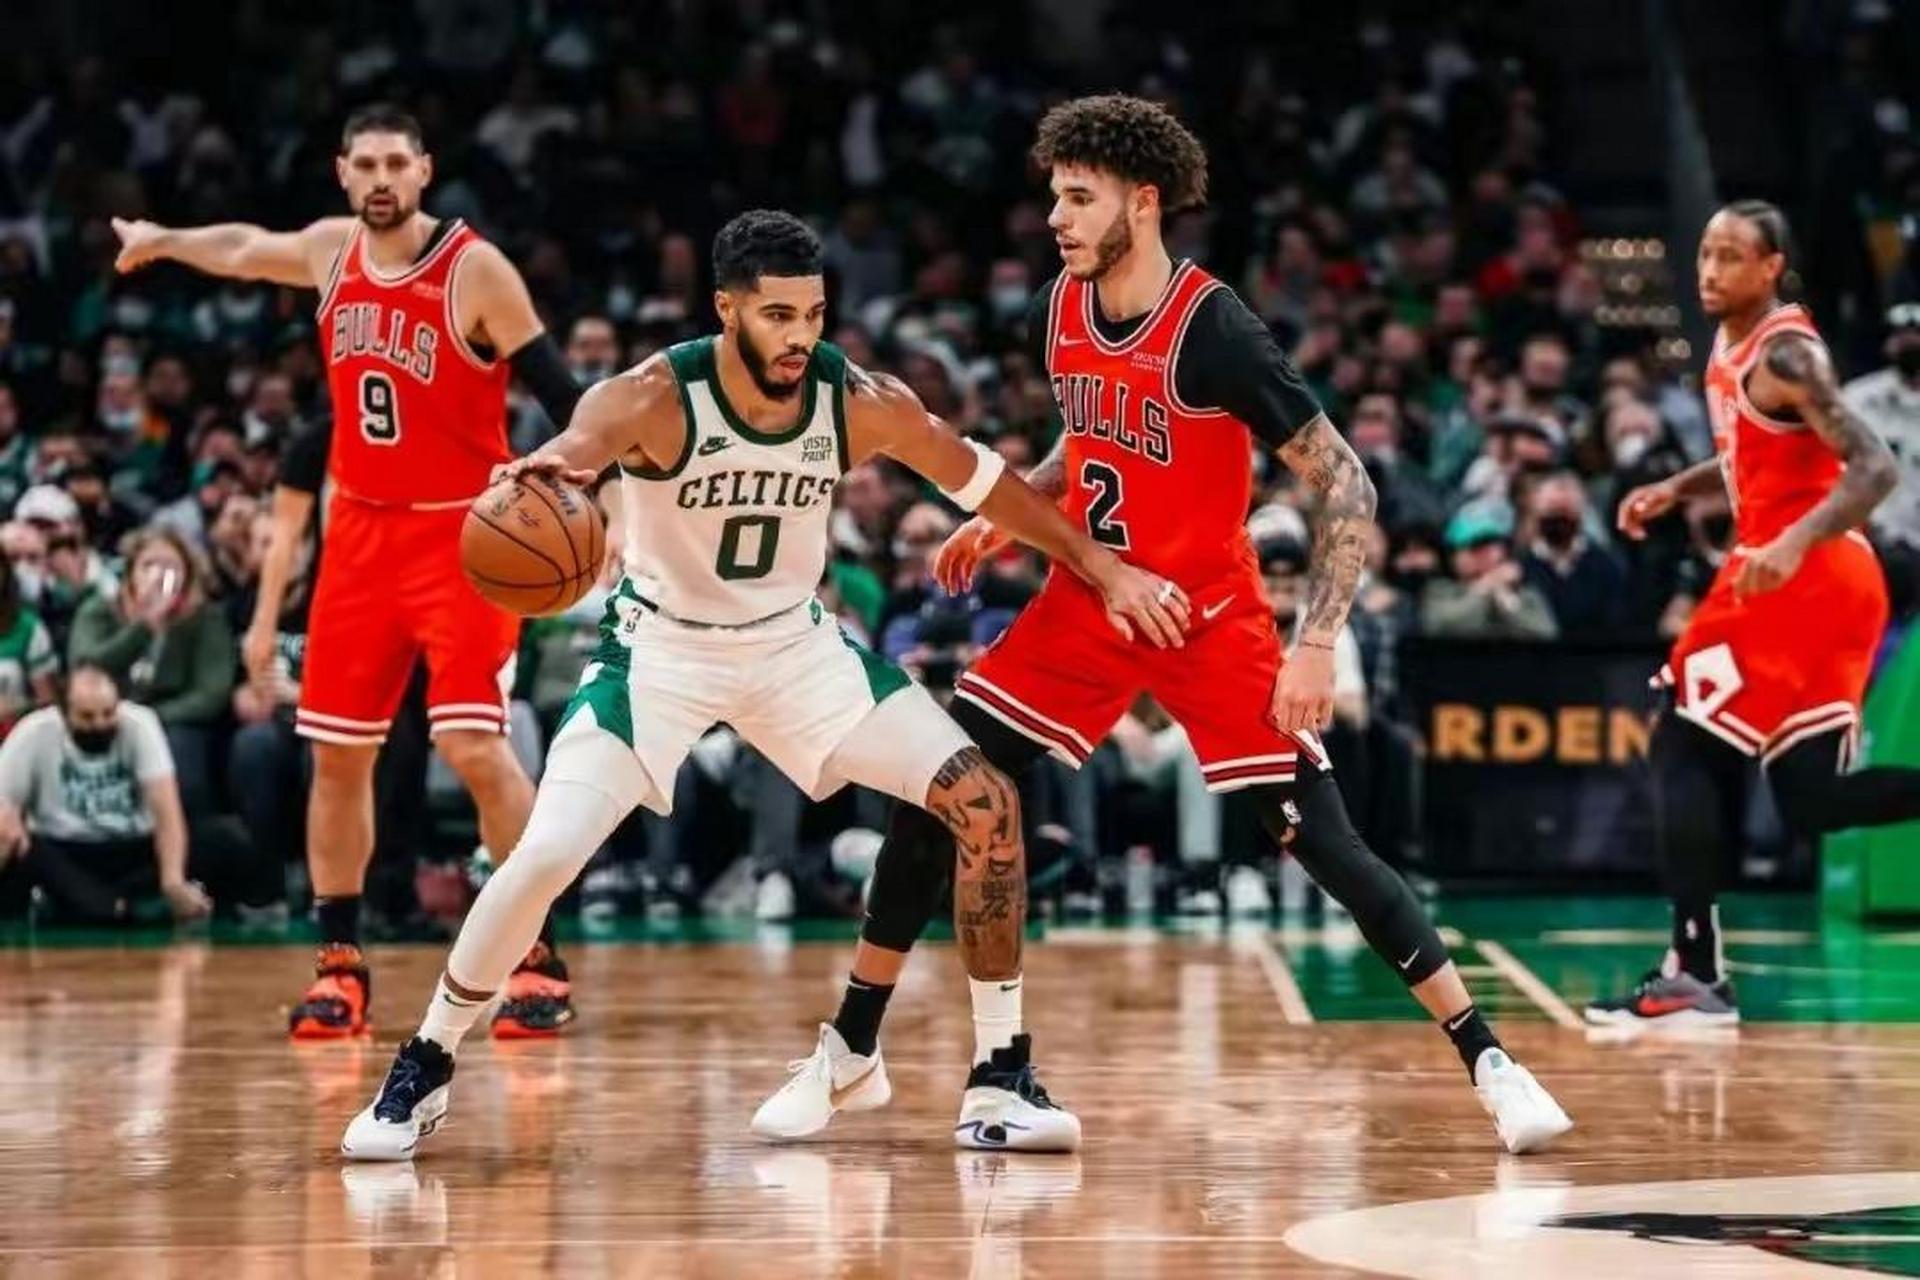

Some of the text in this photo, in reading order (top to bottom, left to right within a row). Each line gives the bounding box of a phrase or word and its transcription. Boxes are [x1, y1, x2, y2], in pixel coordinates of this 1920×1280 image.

[331, 302, 438, 385] BULLS
[360, 370, 400, 446] 9
[802, 435, 832, 451] VISTA
[801, 450, 831, 462] PRINT
[1080, 458, 1132, 552] 2
[715, 513, 782, 581] 0
